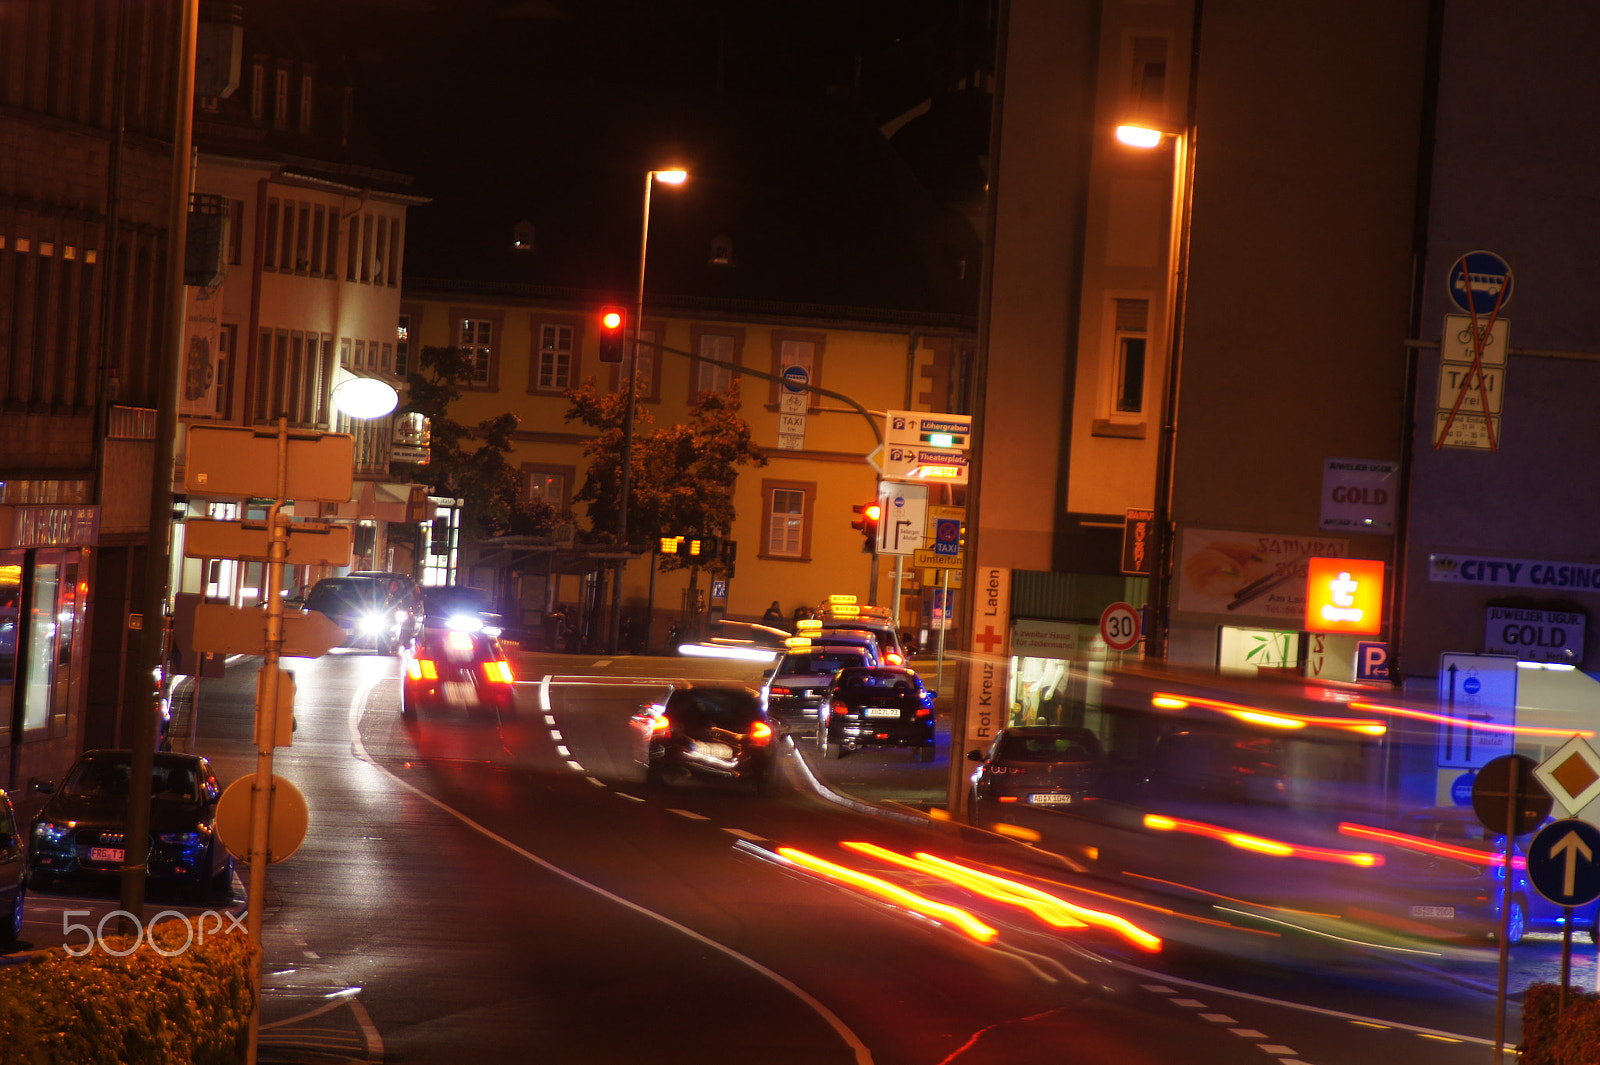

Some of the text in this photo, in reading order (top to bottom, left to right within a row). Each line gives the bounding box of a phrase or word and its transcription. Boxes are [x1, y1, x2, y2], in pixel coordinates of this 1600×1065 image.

[1449, 371, 1495, 392] TAXI
[783, 416, 803, 426] TAXI
[922, 422, 969, 432] Löhergraben
[920, 453, 966, 463] Theaterplatz
[1332, 486, 1388, 506] GOLD
[938, 543, 957, 553] TAXI
[1257, 537, 1346, 556] SAMURAI
[920, 554, 963, 565] Umleitun
[1274, 563, 1309, 578] SUS
[1460, 559, 1600, 588] CITY CASINO
[1490, 608, 1544, 623] JUWELIER
[1109, 616, 1132, 638] 30
[1502, 623, 1567, 648] GOLD
[977, 569, 1000, 738] Rot Kreuz Laden
[1364, 647, 1387, 676] P
